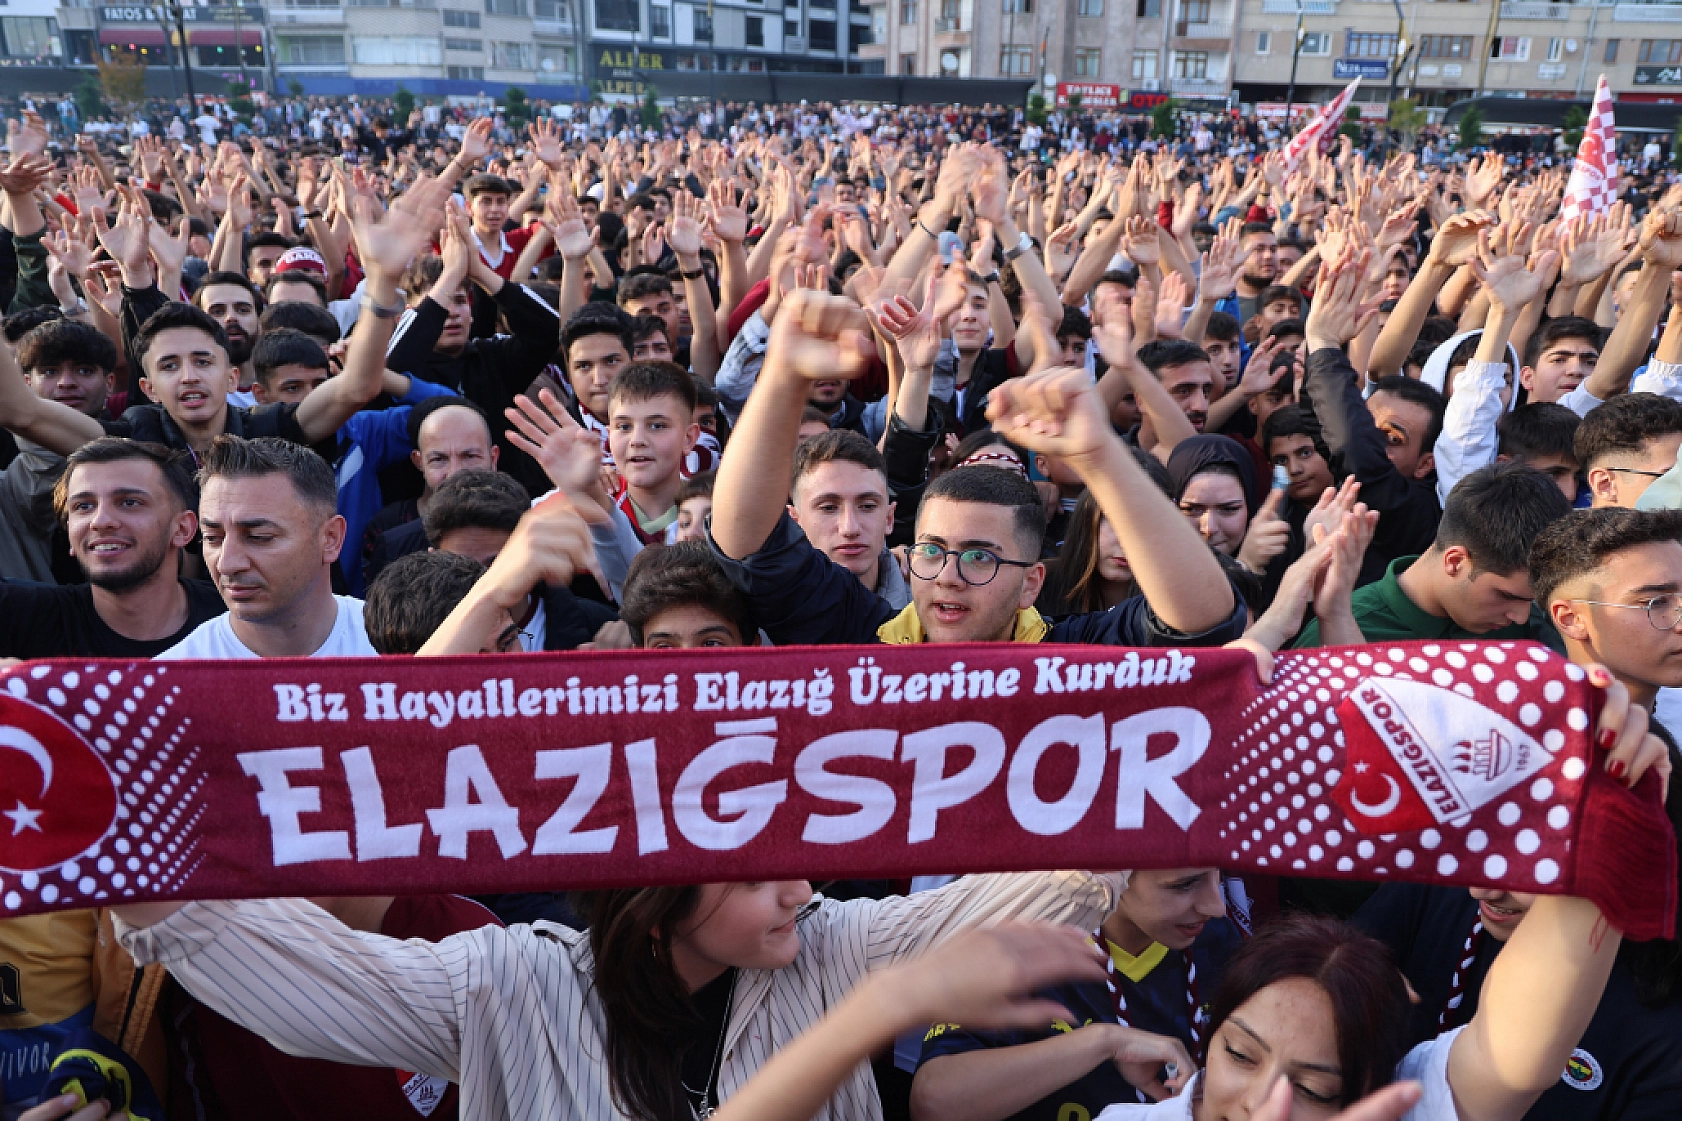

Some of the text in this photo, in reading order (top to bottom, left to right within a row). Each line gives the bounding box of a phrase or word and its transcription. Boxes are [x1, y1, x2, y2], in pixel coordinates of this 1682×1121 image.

[273, 649, 1195, 727] Biz Hayallerimizi Elazığ Üzerine Kurduk
[237, 707, 1212, 866] ELAZIĞSPOR
